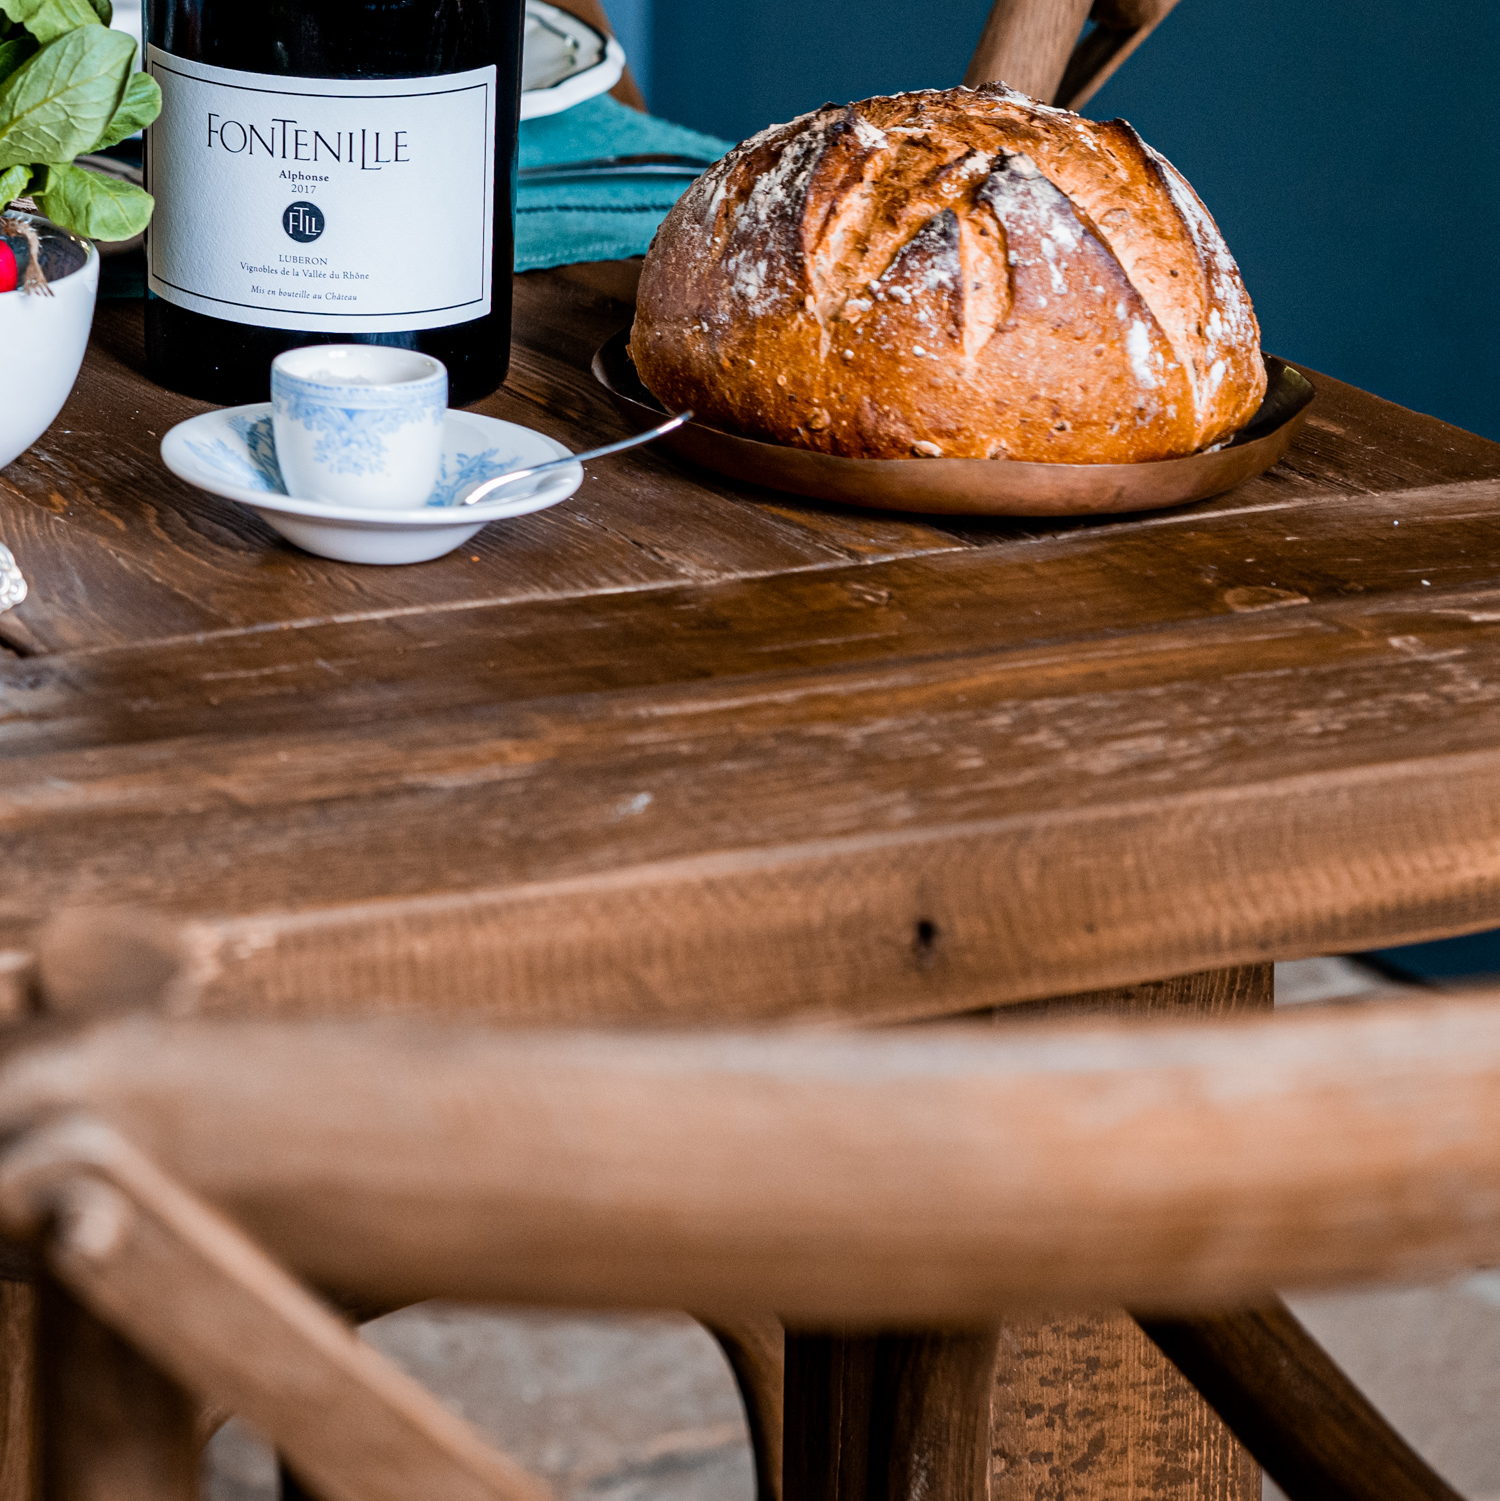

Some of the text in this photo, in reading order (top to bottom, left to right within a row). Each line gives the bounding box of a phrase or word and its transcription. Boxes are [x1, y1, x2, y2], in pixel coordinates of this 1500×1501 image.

[207, 113, 410, 170] FONTENILLE
[278, 170, 330, 182] Alphonse
[291, 184, 316, 194] 2017
[279, 254, 328, 265] LUBERON
[240, 261, 370, 280] Vignobles de la Vallée du Rhône
[251, 285, 265, 294] Mis
[278, 289, 311, 299] bouteille
[325, 292, 358, 301] Château
